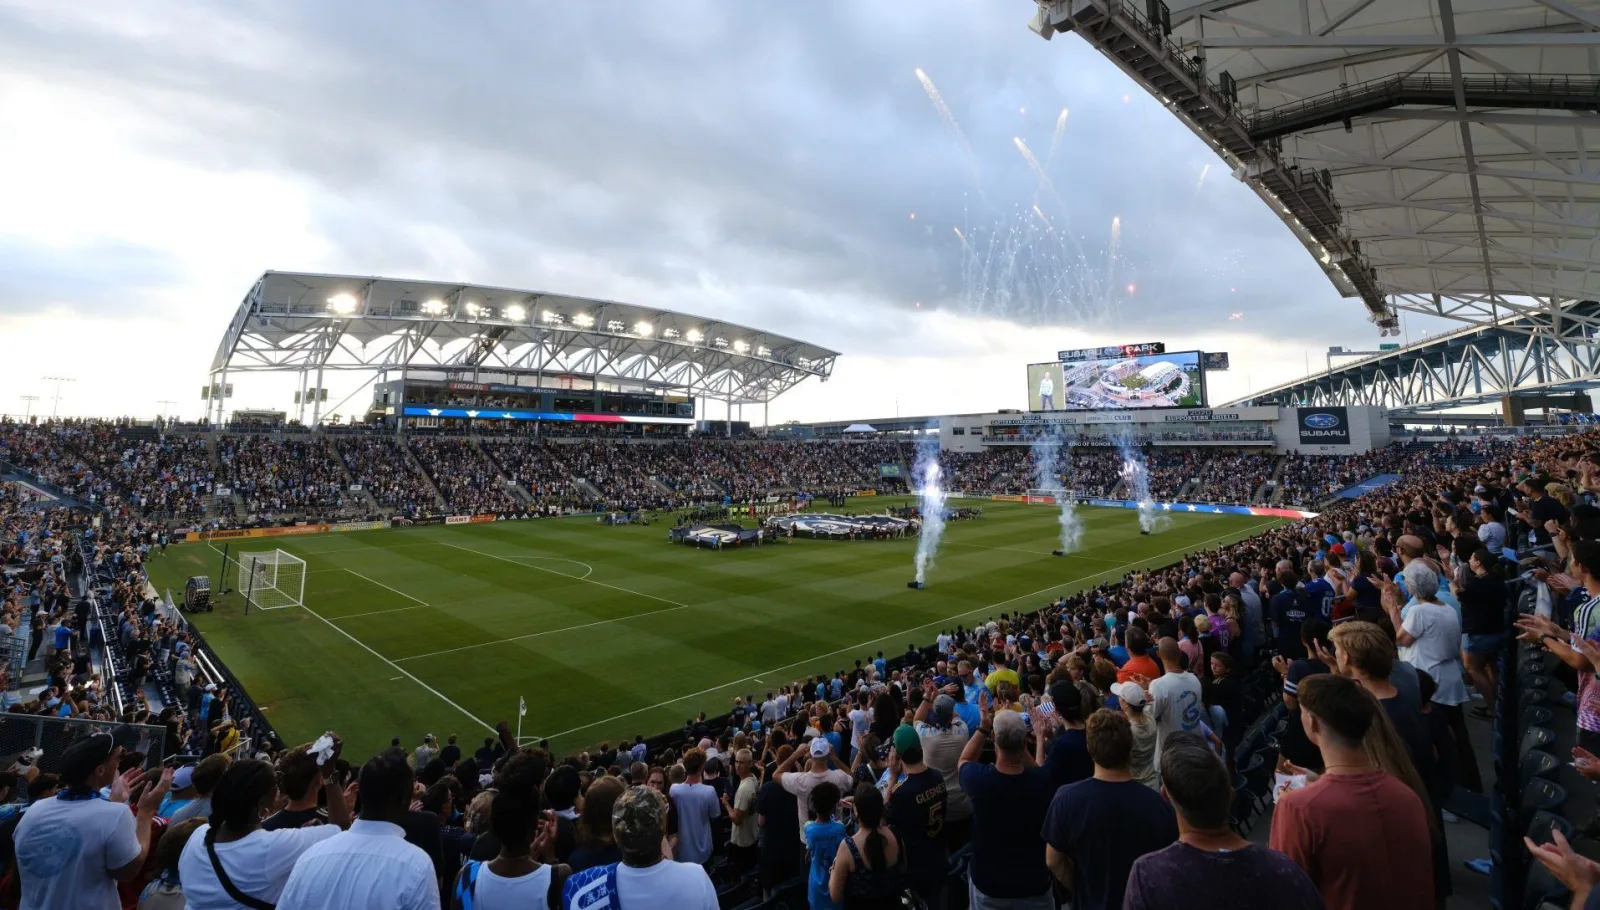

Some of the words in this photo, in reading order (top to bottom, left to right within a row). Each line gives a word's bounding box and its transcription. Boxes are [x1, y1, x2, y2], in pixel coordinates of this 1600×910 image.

[1060, 348, 1102, 359] SUBARU
[1126, 343, 1158, 354] PARK
[199, 530, 244, 539] Continental
[928, 802, 944, 838] 5
